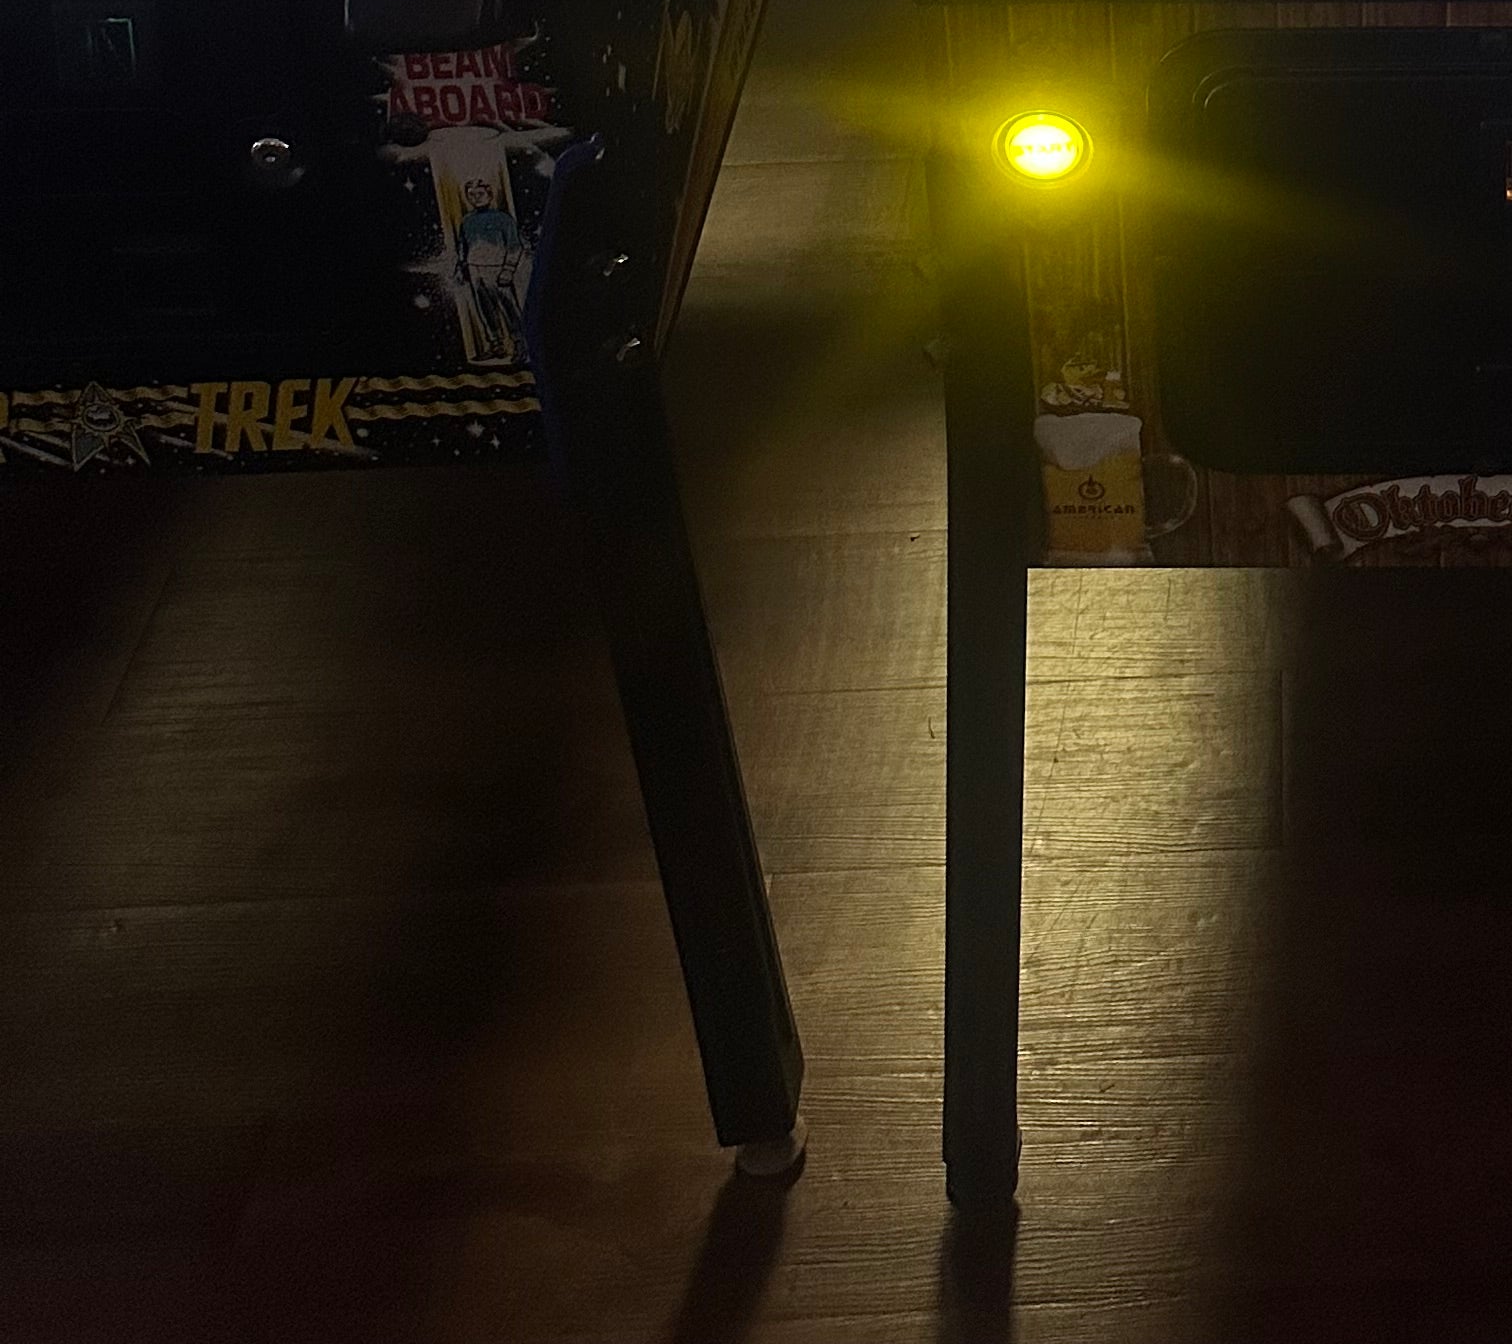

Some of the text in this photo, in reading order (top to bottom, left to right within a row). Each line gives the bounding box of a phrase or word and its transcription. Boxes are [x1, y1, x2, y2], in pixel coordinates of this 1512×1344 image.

[404, 45, 514, 80] BEAM
[389, 83, 553, 123] ABOARD
[190, 377, 360, 454] TREK
[1053, 503, 1136, 515] AMERICAN
